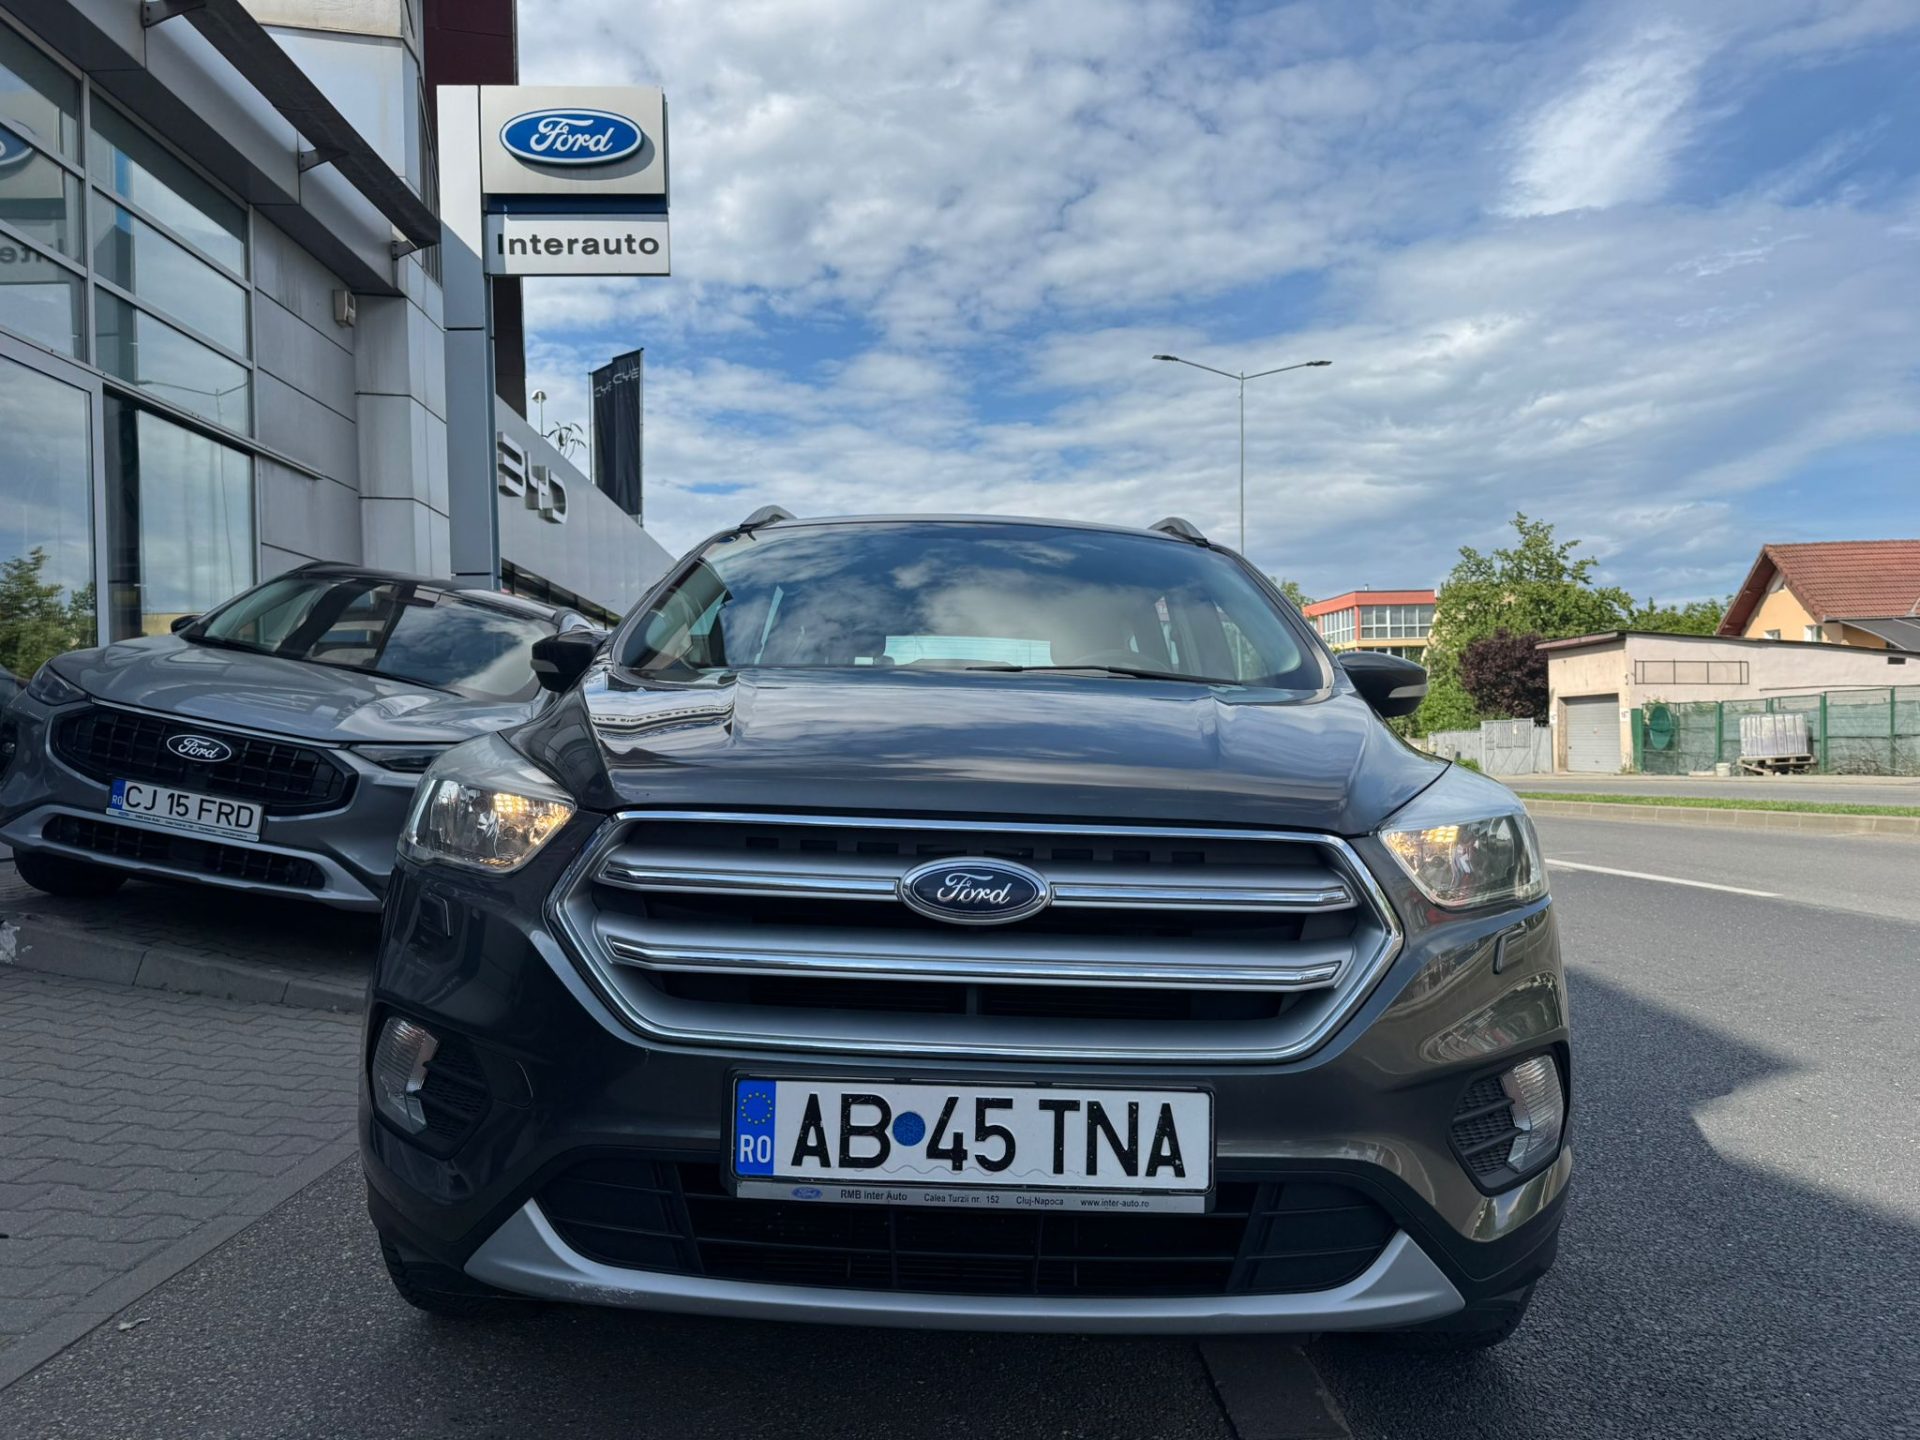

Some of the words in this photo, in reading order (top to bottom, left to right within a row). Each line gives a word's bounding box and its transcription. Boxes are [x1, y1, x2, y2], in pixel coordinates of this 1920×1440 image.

[529, 117, 615, 152] Ford
[497, 232, 660, 256] Interauto
[497, 431, 569, 525] BYD
[178, 738, 219, 758] Ford
[111, 794, 123, 806] RO
[125, 785, 158, 811] CJ
[167, 792, 190, 817] 15
[197, 798, 254, 829] FRD
[936, 872, 1013, 905] Ford
[739, 1134, 772, 1164] RO
[790, 1093, 892, 1169] AB
[926, 1096, 1017, 1172] 45
[1038, 1098, 1187, 1178] TNA
[840, 1189, 862, 1200] RMB
[863, 1190, 885, 1201] Inter
[886, 1191, 909, 1201] Auto
[923, 1193, 946, 1203] Calea
[986, 1195, 1001, 1205] 152
[1015, 1195, 1065, 1207] Cluj-Napoca
[1080, 1199, 1151, 1209] www.inter-auto.ro
